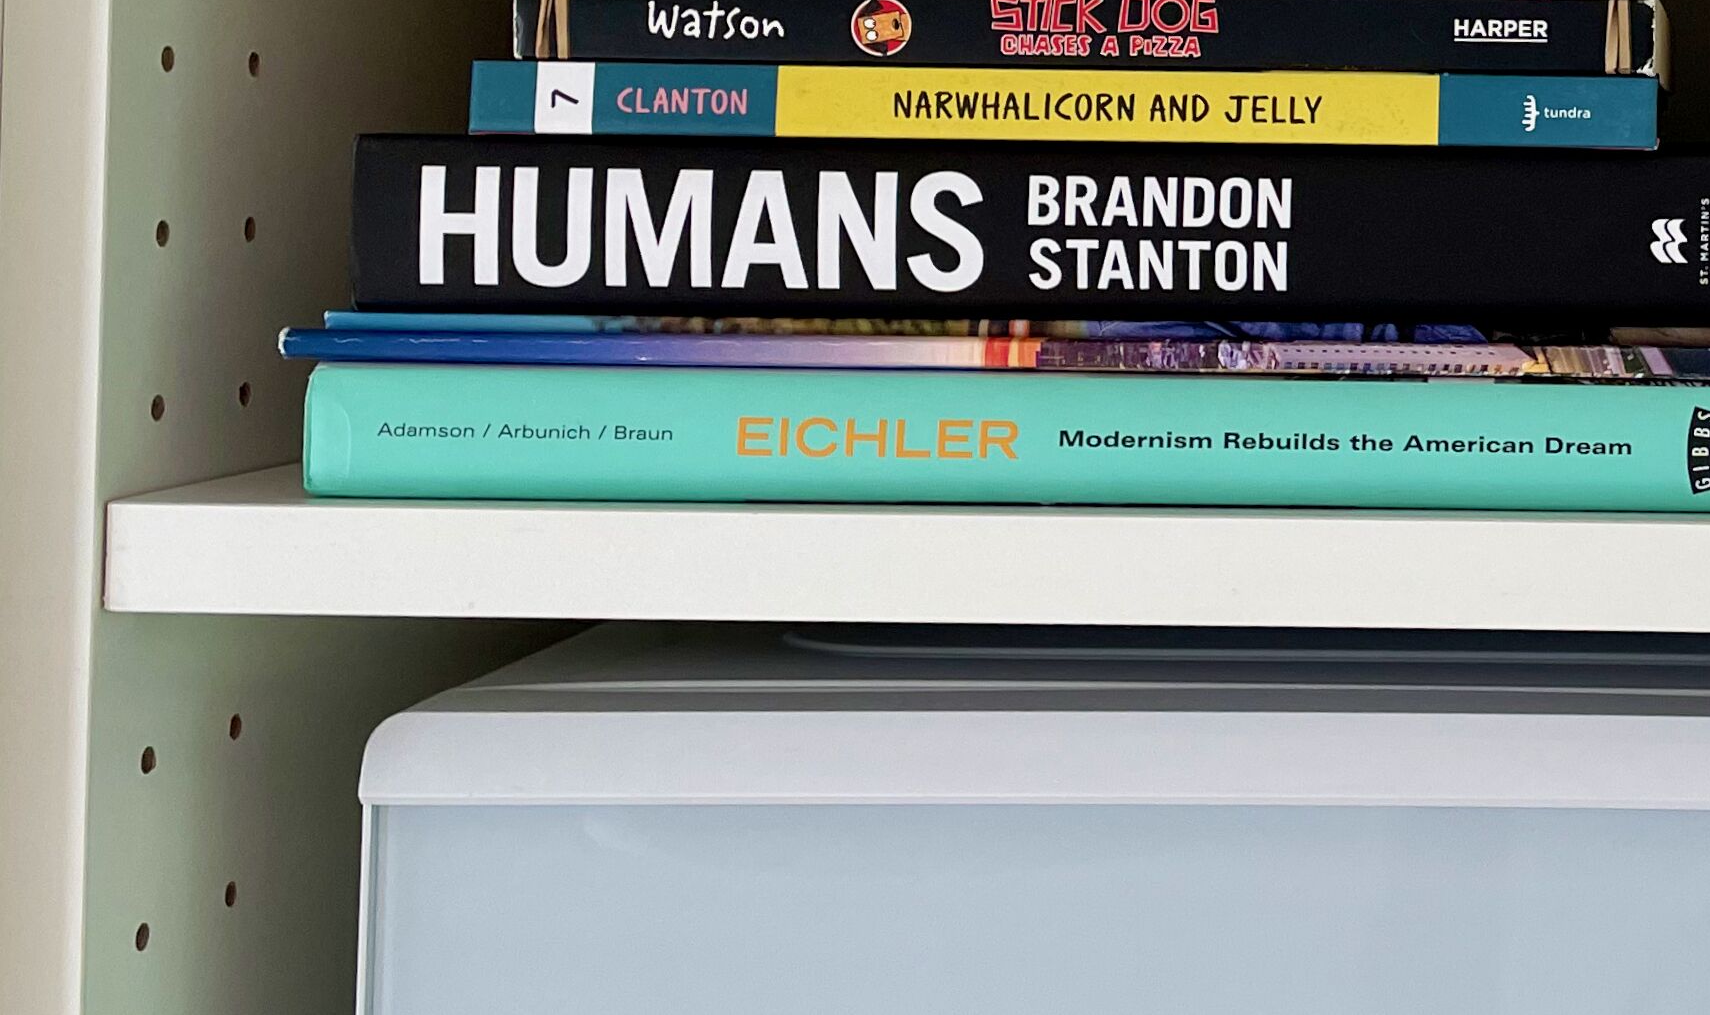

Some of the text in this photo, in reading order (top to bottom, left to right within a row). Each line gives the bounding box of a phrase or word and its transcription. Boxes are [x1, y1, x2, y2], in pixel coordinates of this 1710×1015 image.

[647, 0, 785, 39] Watson
[1453, 18, 1549, 40] HARPER
[1000, 33, 1092, 57] CHASES
[1100, 35, 1120, 57] A
[551, 89, 579, 108] 7
[615, 87, 748, 115] CLANTON
[893, 91, 1323, 125] NARWHALICORN AND JELLY
[1543, 104, 1592, 120] tundra
[1028, 175, 1294, 230] BRANDON
[417, 165, 985, 293] HUMANS
[1699, 198, 1710, 285] ST. MARTIN'S
[1027, 235, 1290, 292] STANTON
[377, 421, 475, 439] Adamson
[498, 423, 591, 440] Arbunich
[613, 425, 673, 441] Braun
[736, 417, 1018, 460] EICHLER
[1058, 428, 1632, 456] Modernism Rebuilds the American Dream
